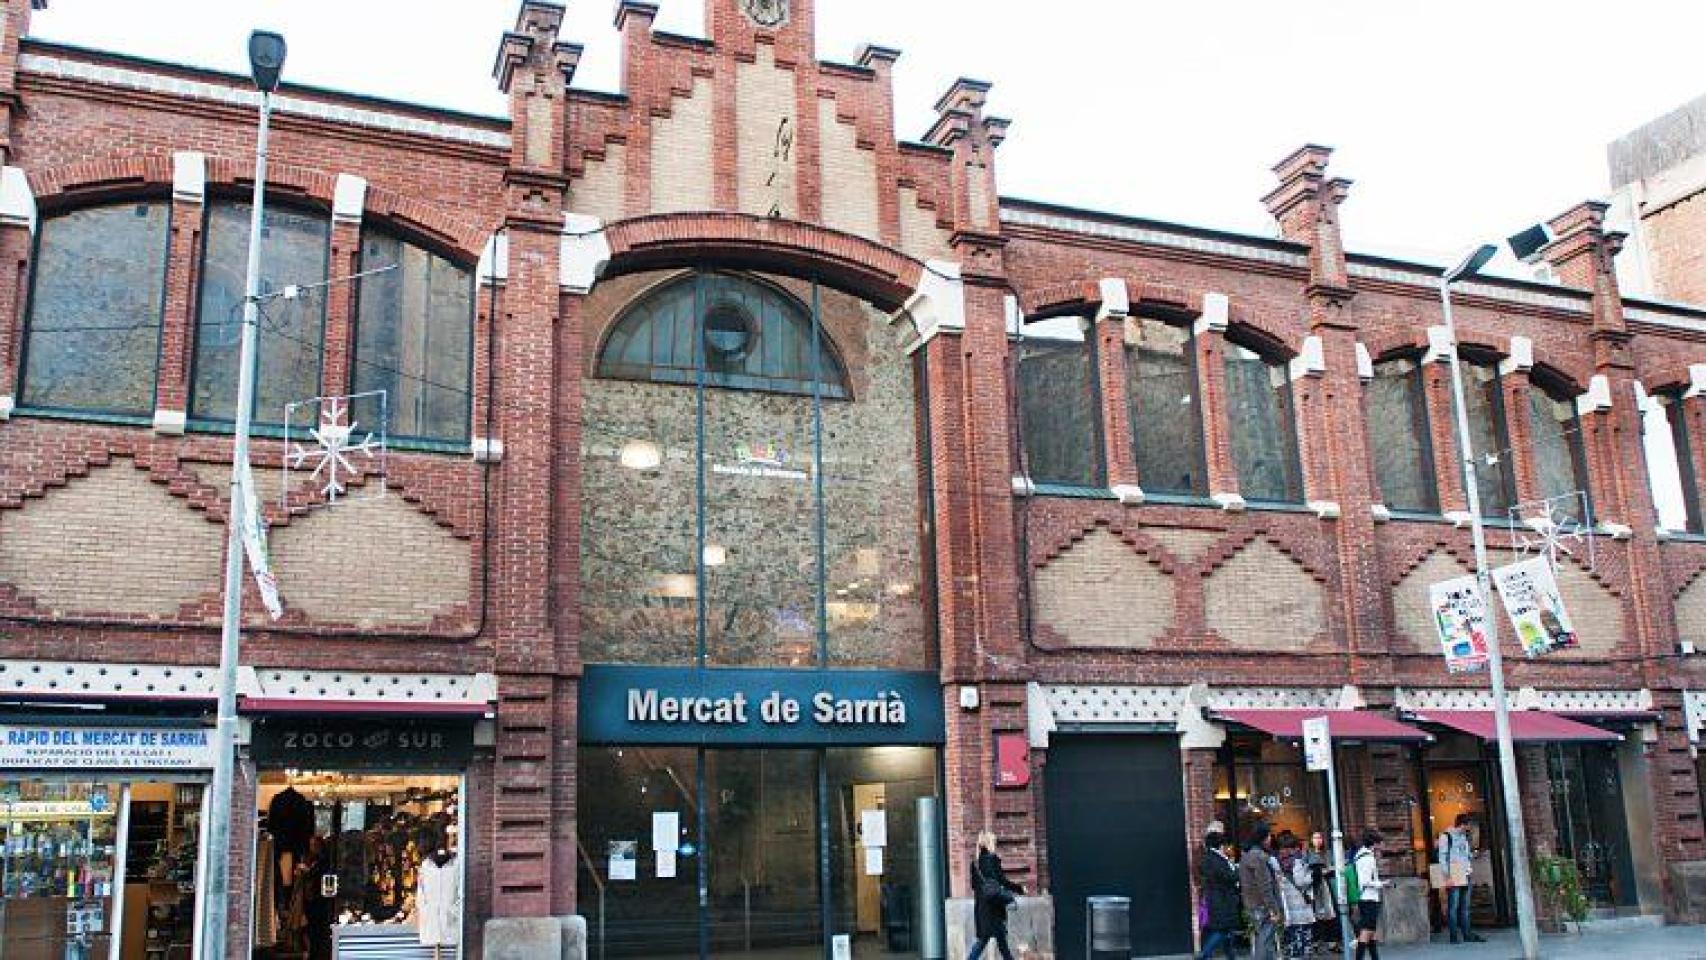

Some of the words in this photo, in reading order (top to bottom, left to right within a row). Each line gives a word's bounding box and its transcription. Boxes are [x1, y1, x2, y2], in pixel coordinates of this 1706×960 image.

[627, 688, 748, 723] Mercat
[760, 690, 800, 723] de
[813, 690, 906, 723] Sarrià
[53, 730, 78, 746] DEL
[82, 730, 137, 746] MERCAT
[140, 731, 158, 746] DE
[284, 732, 354, 748] ZOCO
[399, 732, 443, 748] SUR
